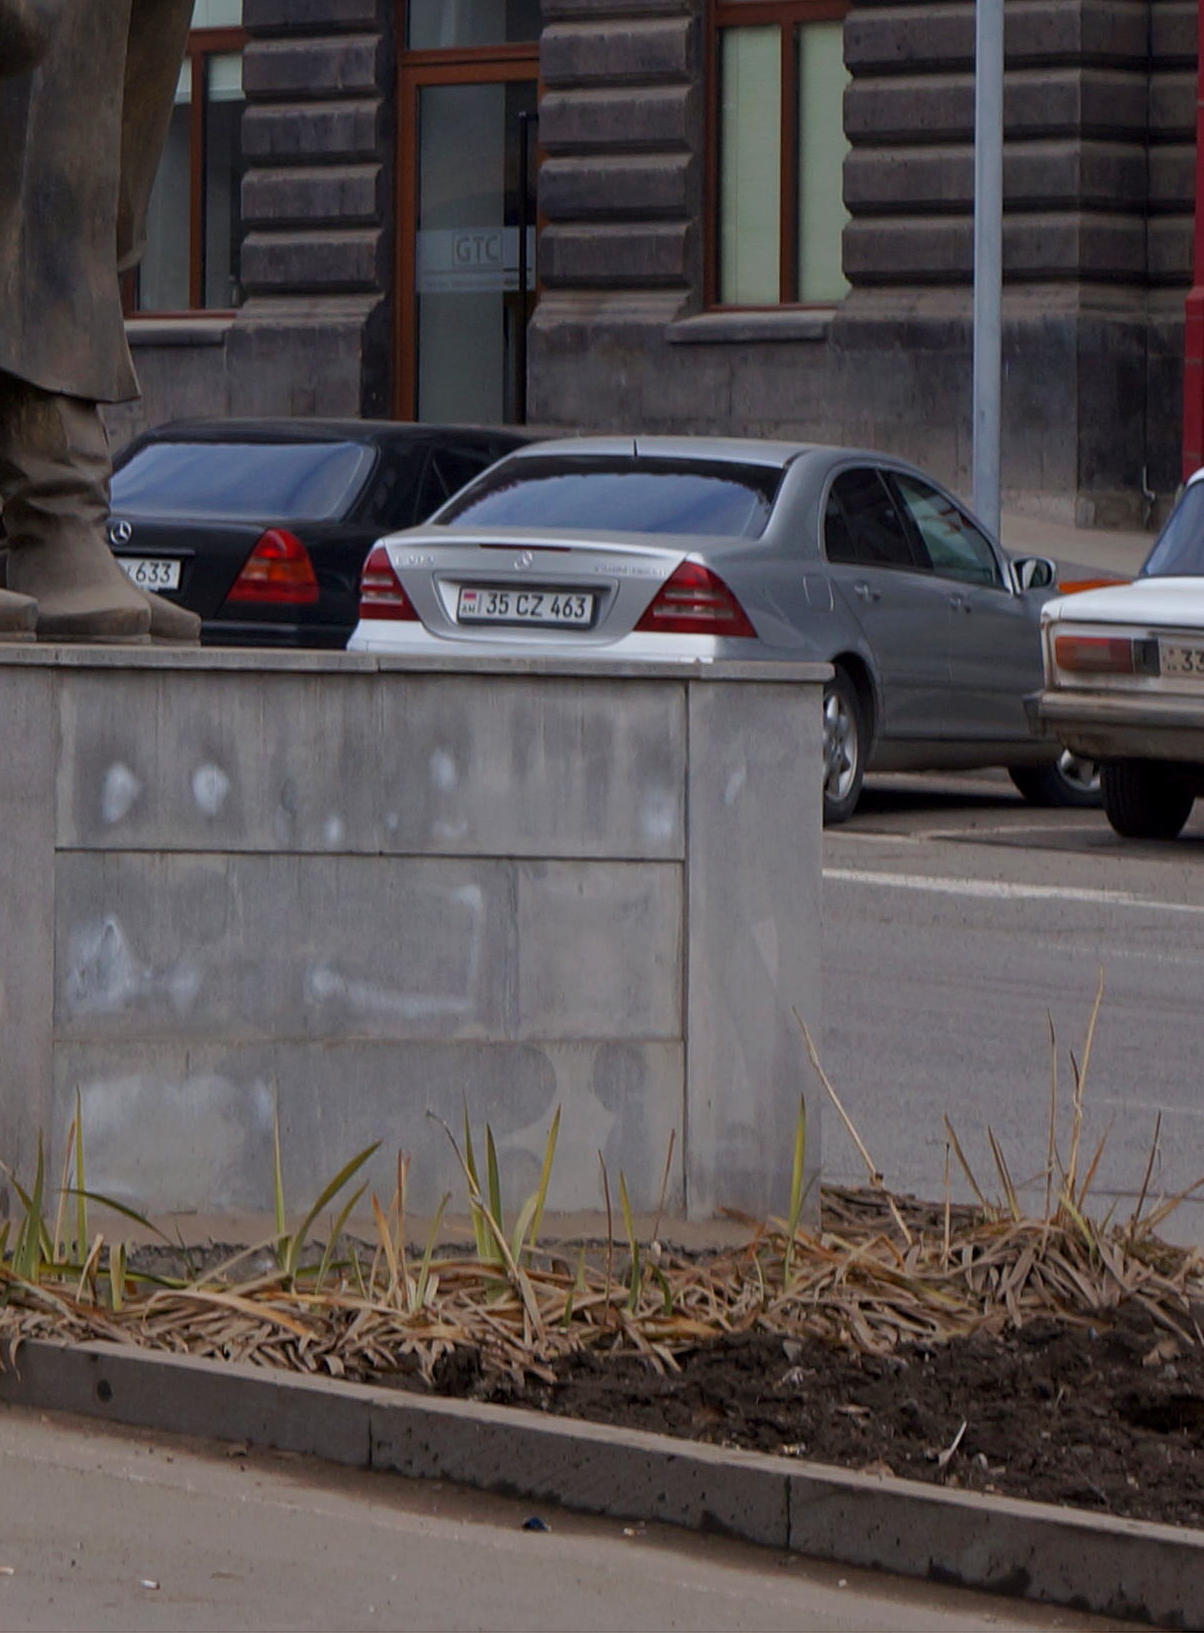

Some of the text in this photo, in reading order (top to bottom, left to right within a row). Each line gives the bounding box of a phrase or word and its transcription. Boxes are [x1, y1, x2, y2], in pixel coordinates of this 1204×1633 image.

[456, 235, 499, 262] GTC
[136, 561, 172, 583] 633
[486, 593, 586, 618] 35 CZ 463
